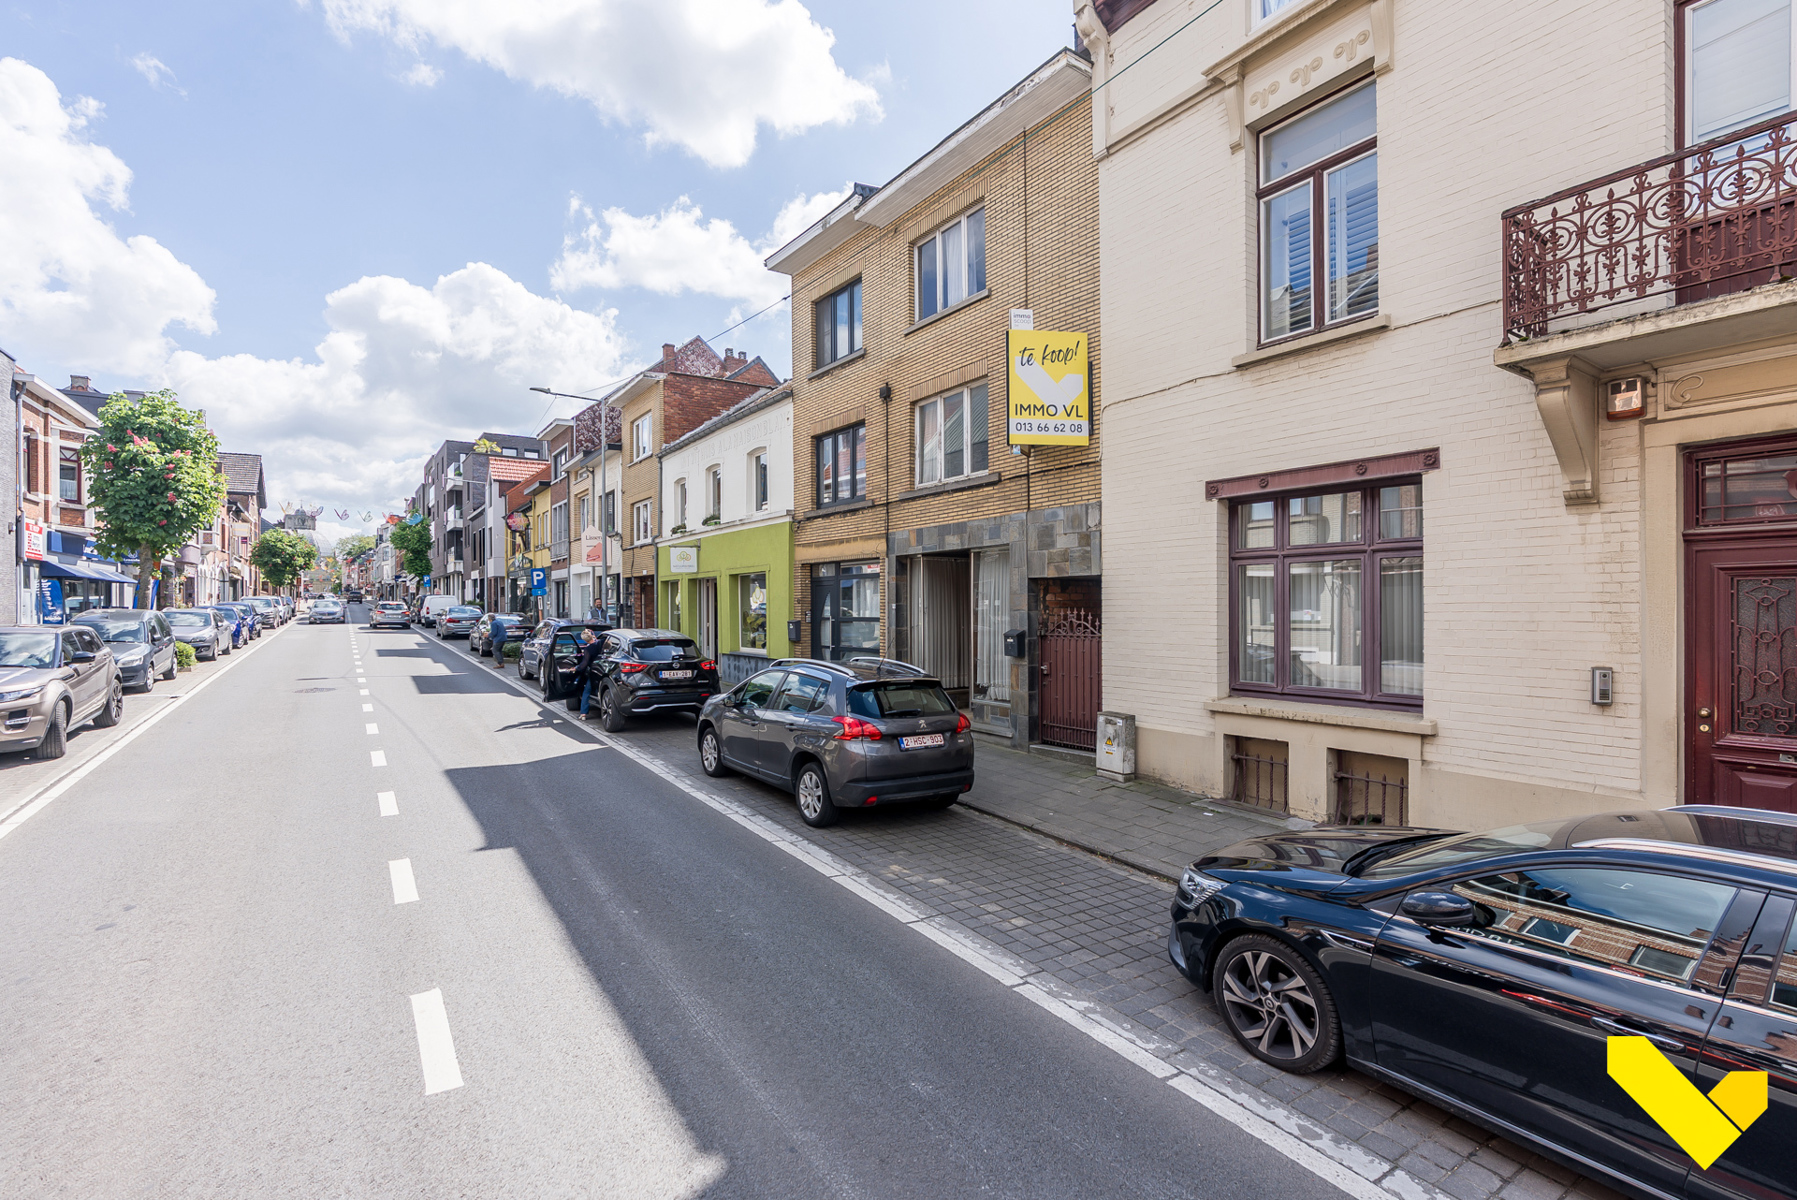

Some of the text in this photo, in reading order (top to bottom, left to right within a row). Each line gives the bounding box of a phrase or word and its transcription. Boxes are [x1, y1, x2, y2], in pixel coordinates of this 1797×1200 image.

[1019, 340, 1080, 367] te koop!
[1015, 403, 1083, 418] IMMO VL
[1015, 422, 1083, 433] 013 66 62 08
[532, 571, 544, 586] P
